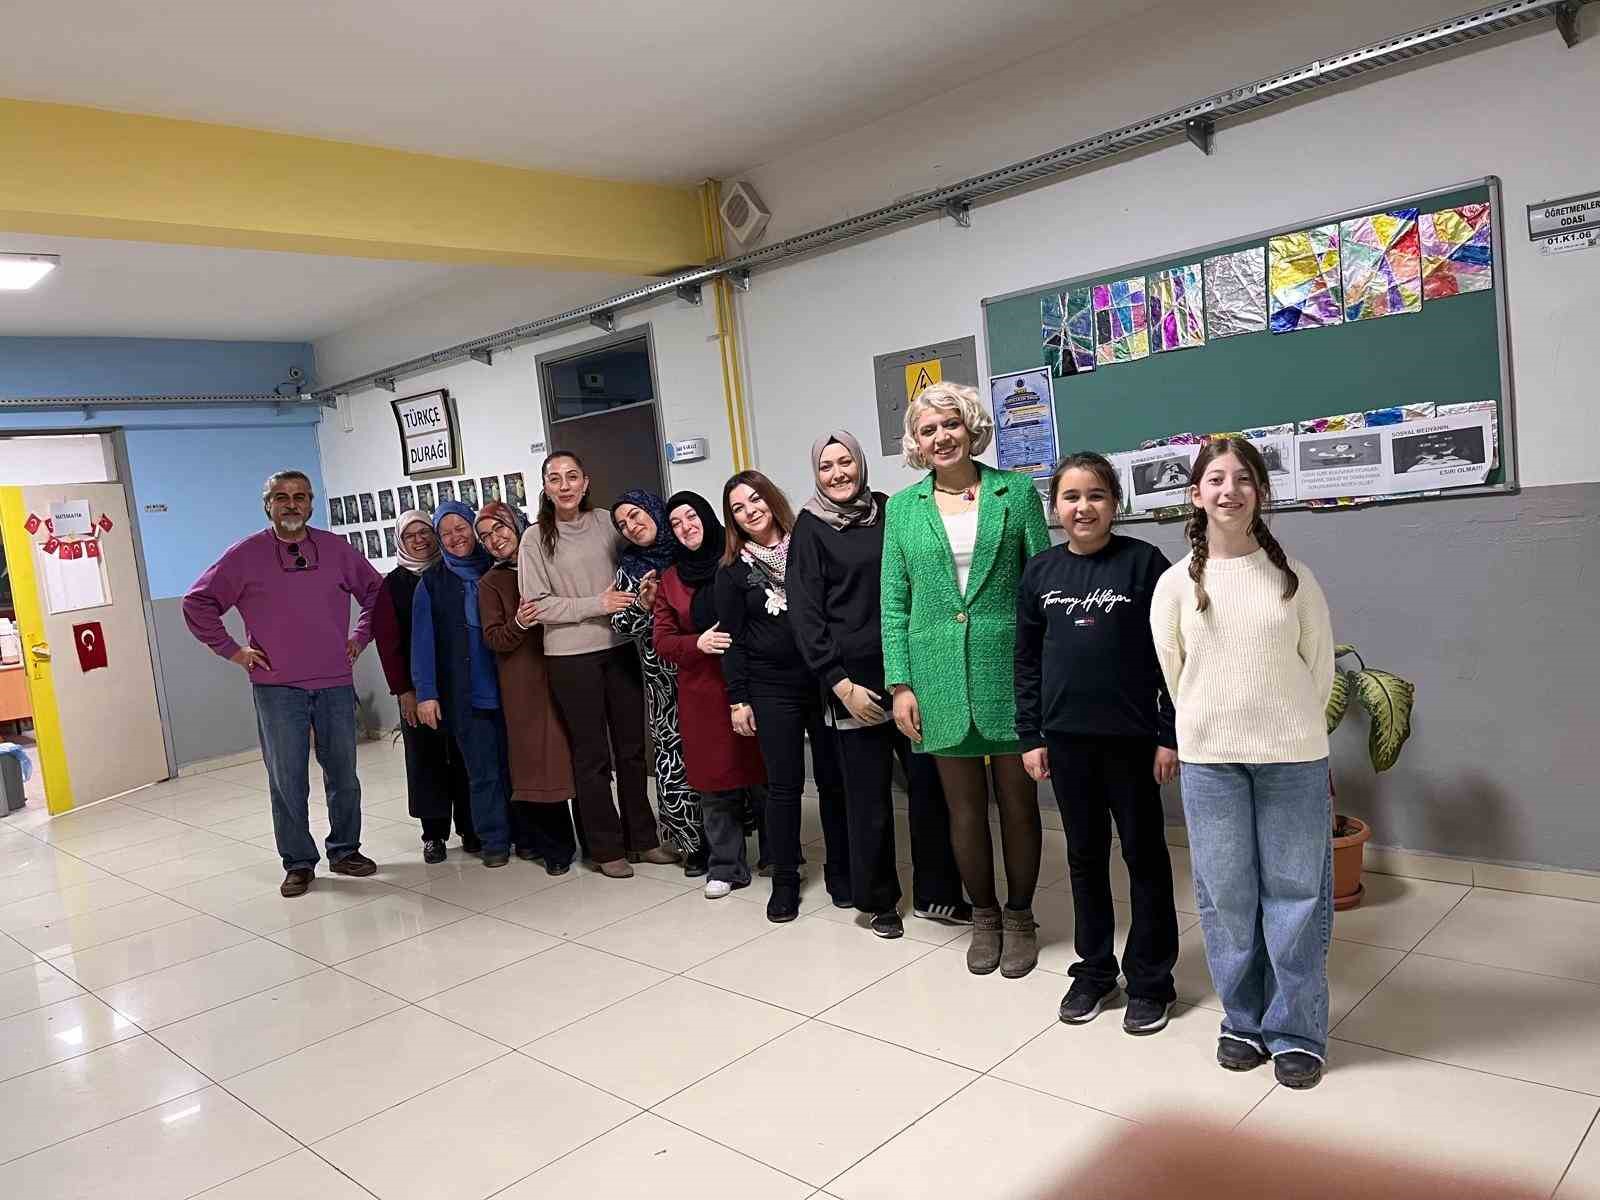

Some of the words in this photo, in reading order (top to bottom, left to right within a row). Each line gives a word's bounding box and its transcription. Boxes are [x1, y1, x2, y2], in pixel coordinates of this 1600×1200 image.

[1560, 214, 1586, 226] ODASI
[403, 406, 441, 428] TÜRKÇE
[410, 440, 448, 464] DURAĞI
[1041, 590, 1081, 615] Tommy
[1081, 588, 1132, 613] Hilfiger
